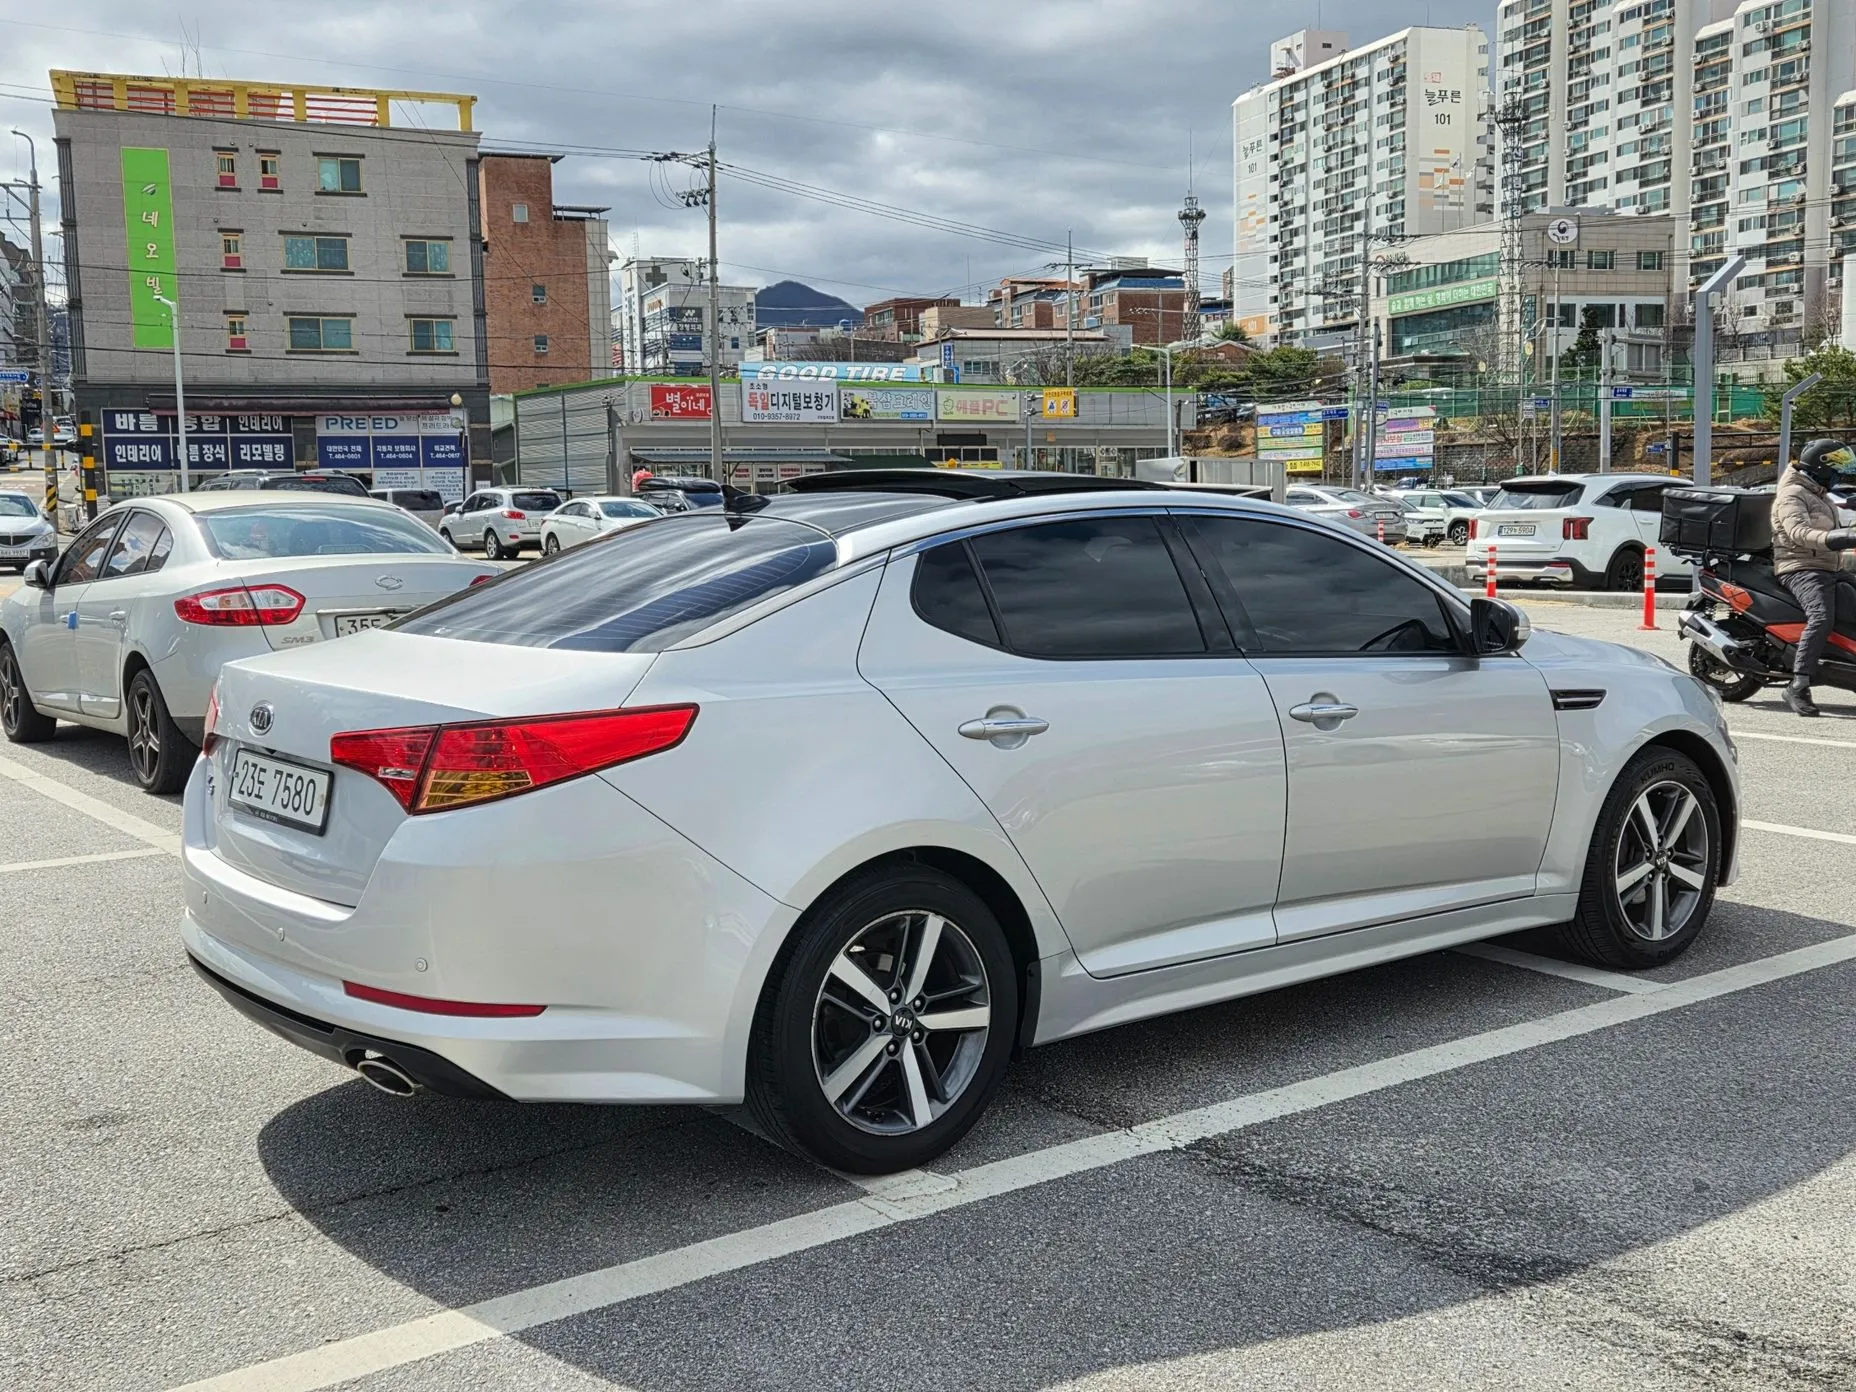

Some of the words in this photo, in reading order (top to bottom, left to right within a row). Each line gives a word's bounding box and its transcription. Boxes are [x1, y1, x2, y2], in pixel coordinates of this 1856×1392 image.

[1424, 88, 1462, 106] 늘푸른
[1434, 112, 1451, 125] 101
[1242, 139, 1263, 160] 늘푸른
[1247, 162, 1257, 174] 101
[142, 211, 163, 295] 네오빌
[1470, 283, 1494, 297] 대한민국
[757, 366, 839, 381] GOOD
[846, 366, 908, 381] TIRE
[749, 382, 769, 390] 초소형
[666, 391, 705, 413] 별이네
[956, 399, 1009, 416] 애플PC
[114, 413, 158, 431] 바름
[237, 415, 283, 431] 인테리어
[325, 417, 398, 430] PREED
[752, 413, 801, 421] 010-9357-8972
[115, 444, 162, 462] 인테리어
[202, 444, 225, 462] 장식
[239, 444, 284, 462] 리모델링
[281, 635, 315, 644] SM3
[251, 709, 268, 728] KIA
[1640, 762, 1675, 784] KUMHO
[238, 759, 267, 800] 23도
[271, 769, 316, 816] 7580
[895, 1014, 913, 1030] KIA
